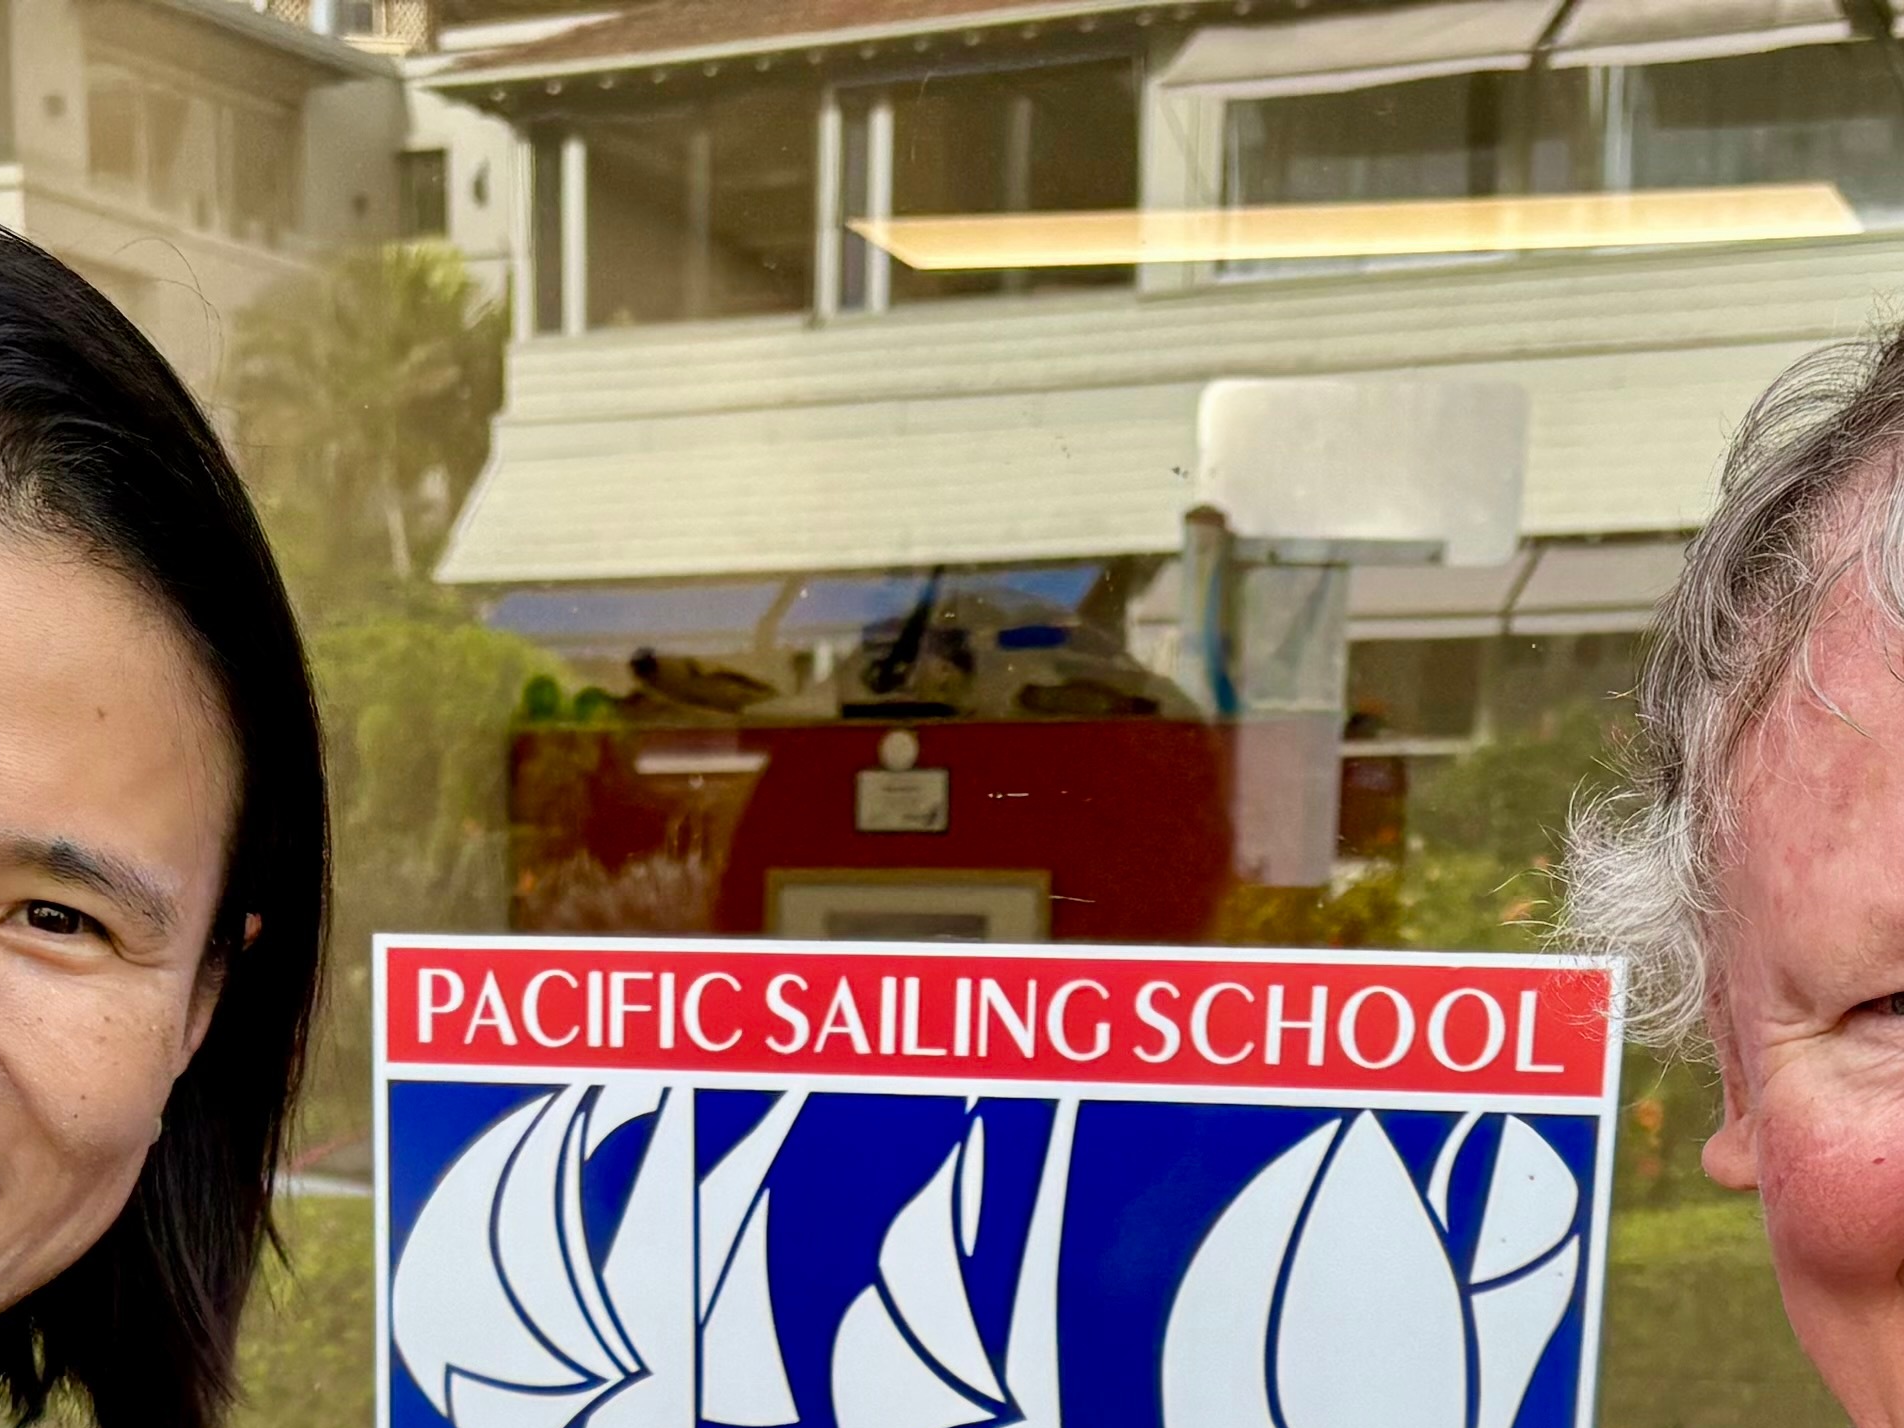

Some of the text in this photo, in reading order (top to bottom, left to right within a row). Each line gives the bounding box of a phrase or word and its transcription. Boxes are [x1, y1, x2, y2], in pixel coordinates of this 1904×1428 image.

[416, 965, 1565, 1077] PACIFIC SAILING SCHOOL
